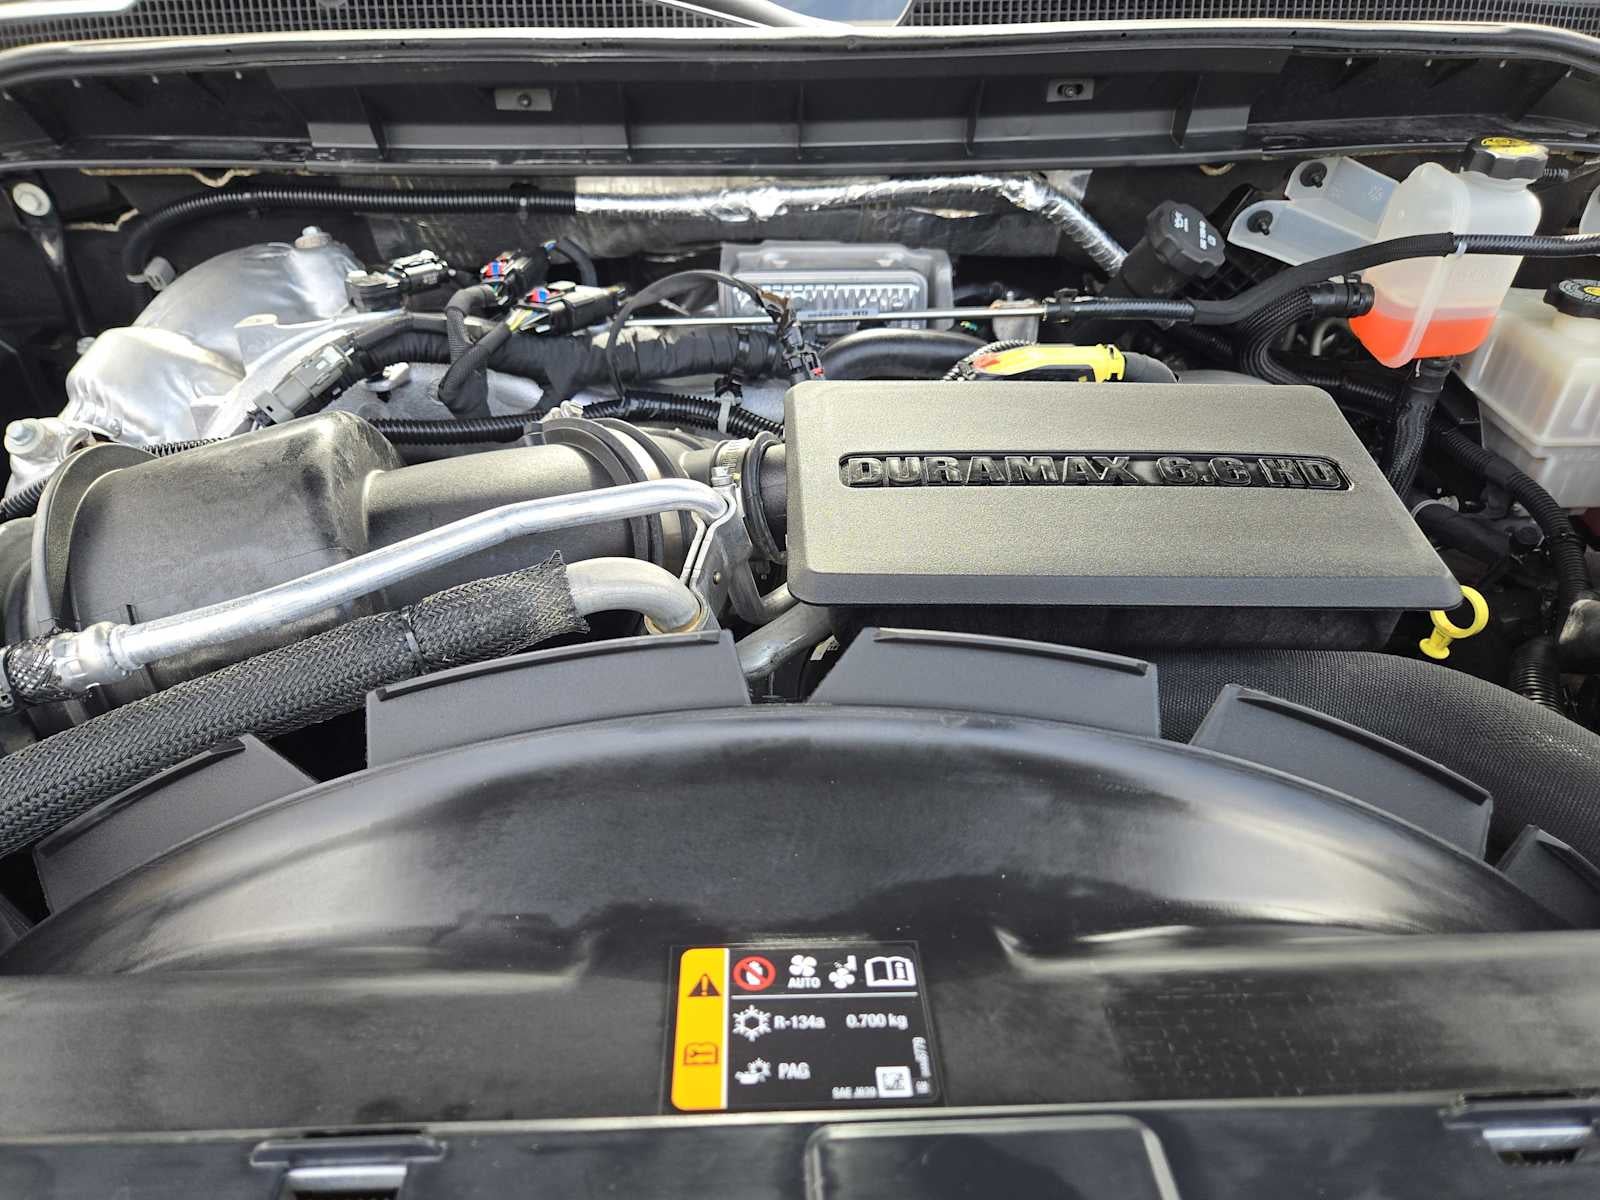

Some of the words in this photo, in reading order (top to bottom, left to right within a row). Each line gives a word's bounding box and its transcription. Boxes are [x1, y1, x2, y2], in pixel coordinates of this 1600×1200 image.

[847, 456, 1138, 486] DURAMAX
[1156, 456, 1252, 486] 6.6
[1257, 458, 1342, 488] HD
[787, 977, 821, 989] AUTO
[773, 1015, 826, 1029] R-134a
[846, 1013, 887, 1028] 0.700
[888, 1013, 908, 1030] kg
[778, 1062, 811, 1080] PAG
[832, 1086, 852, 1099] SAE
